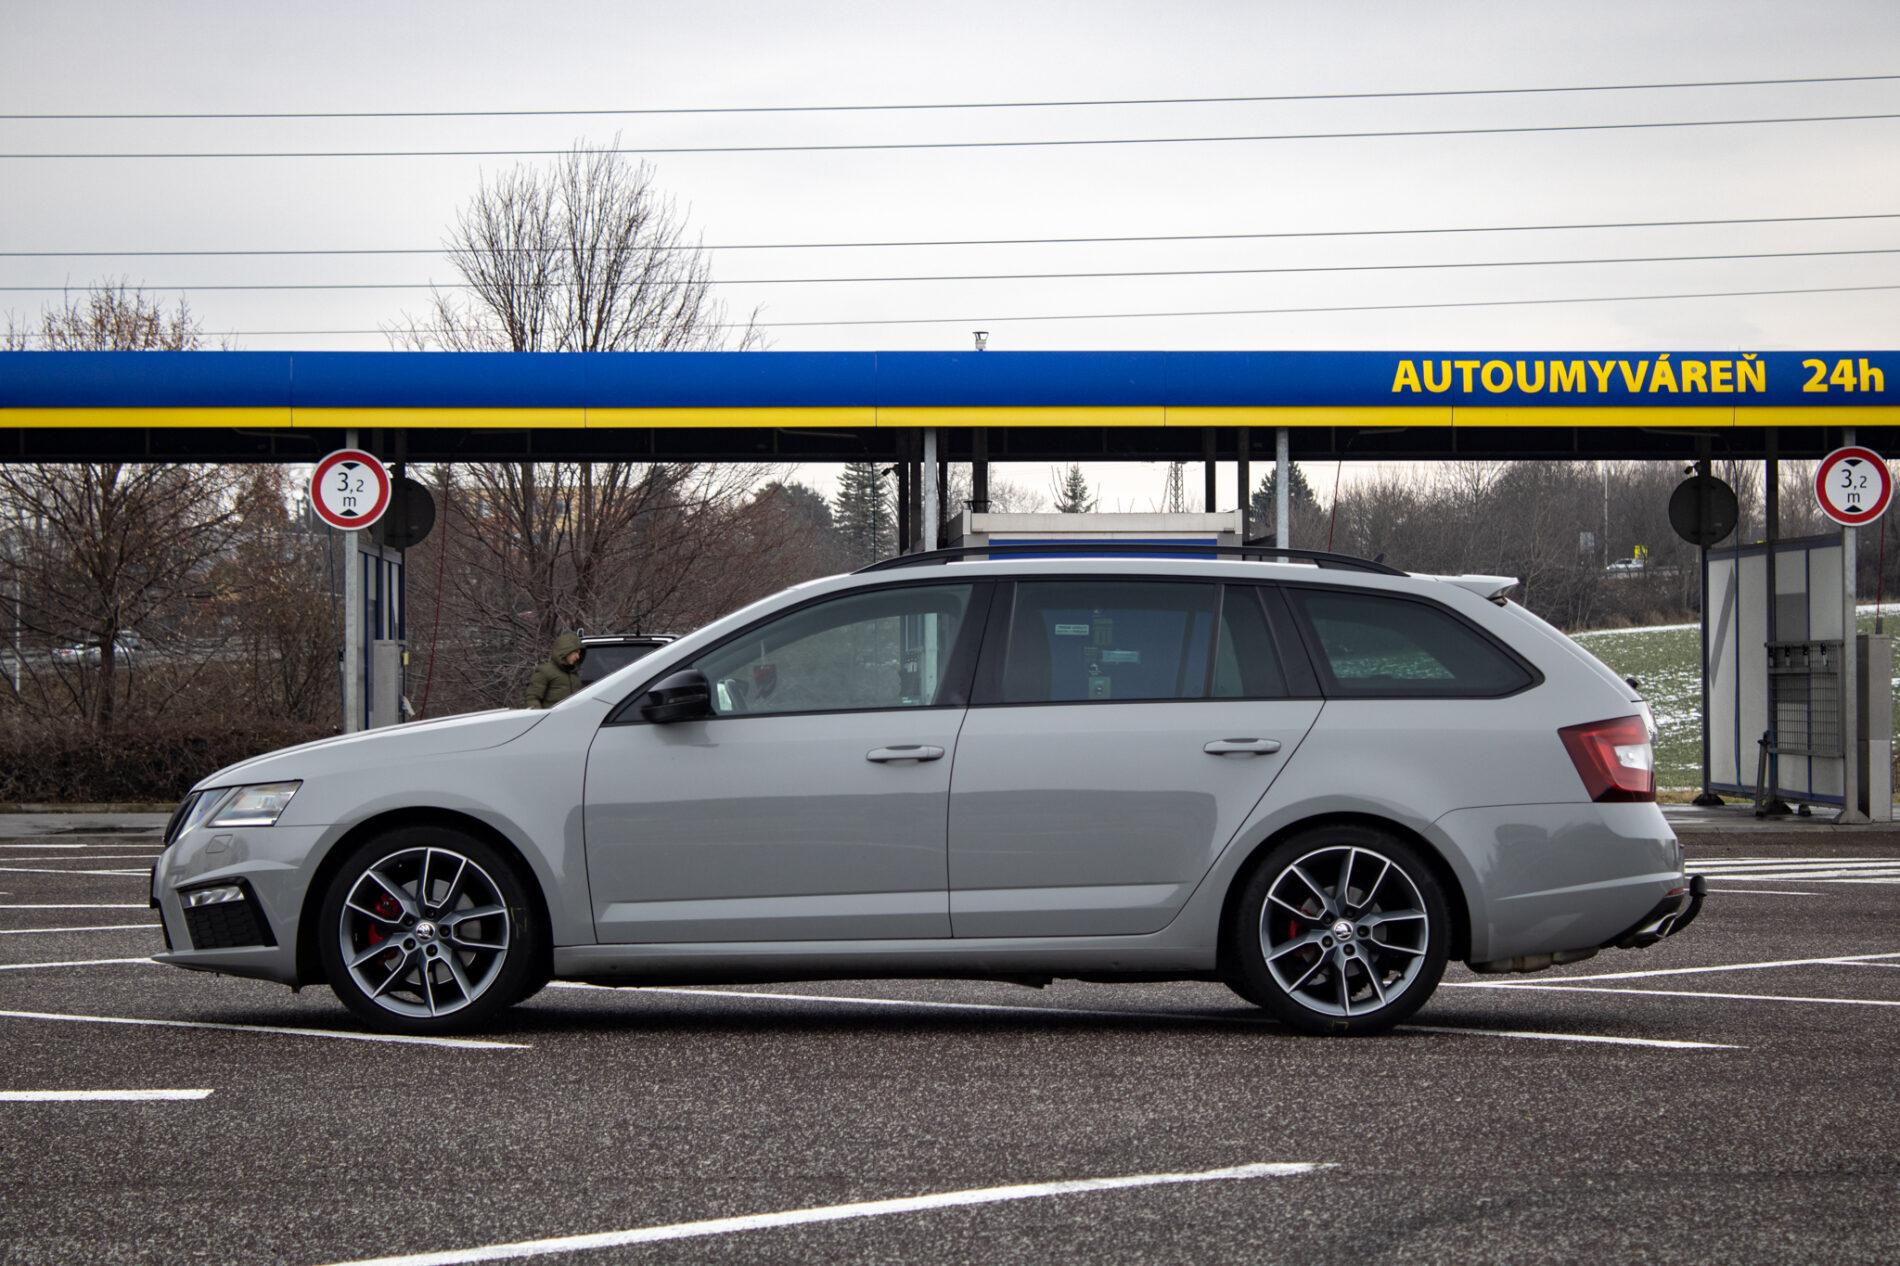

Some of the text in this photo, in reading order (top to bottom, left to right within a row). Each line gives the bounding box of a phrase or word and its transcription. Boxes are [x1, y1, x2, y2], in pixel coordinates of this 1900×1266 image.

[1391, 353, 1885, 394] AUTOUMYVÁREŇ 24h
[337, 472, 364, 493] 3,2
[1841, 468, 1868, 490] 3,2
[342, 496, 357, 507] m
[1847, 493, 1861, 503] m
